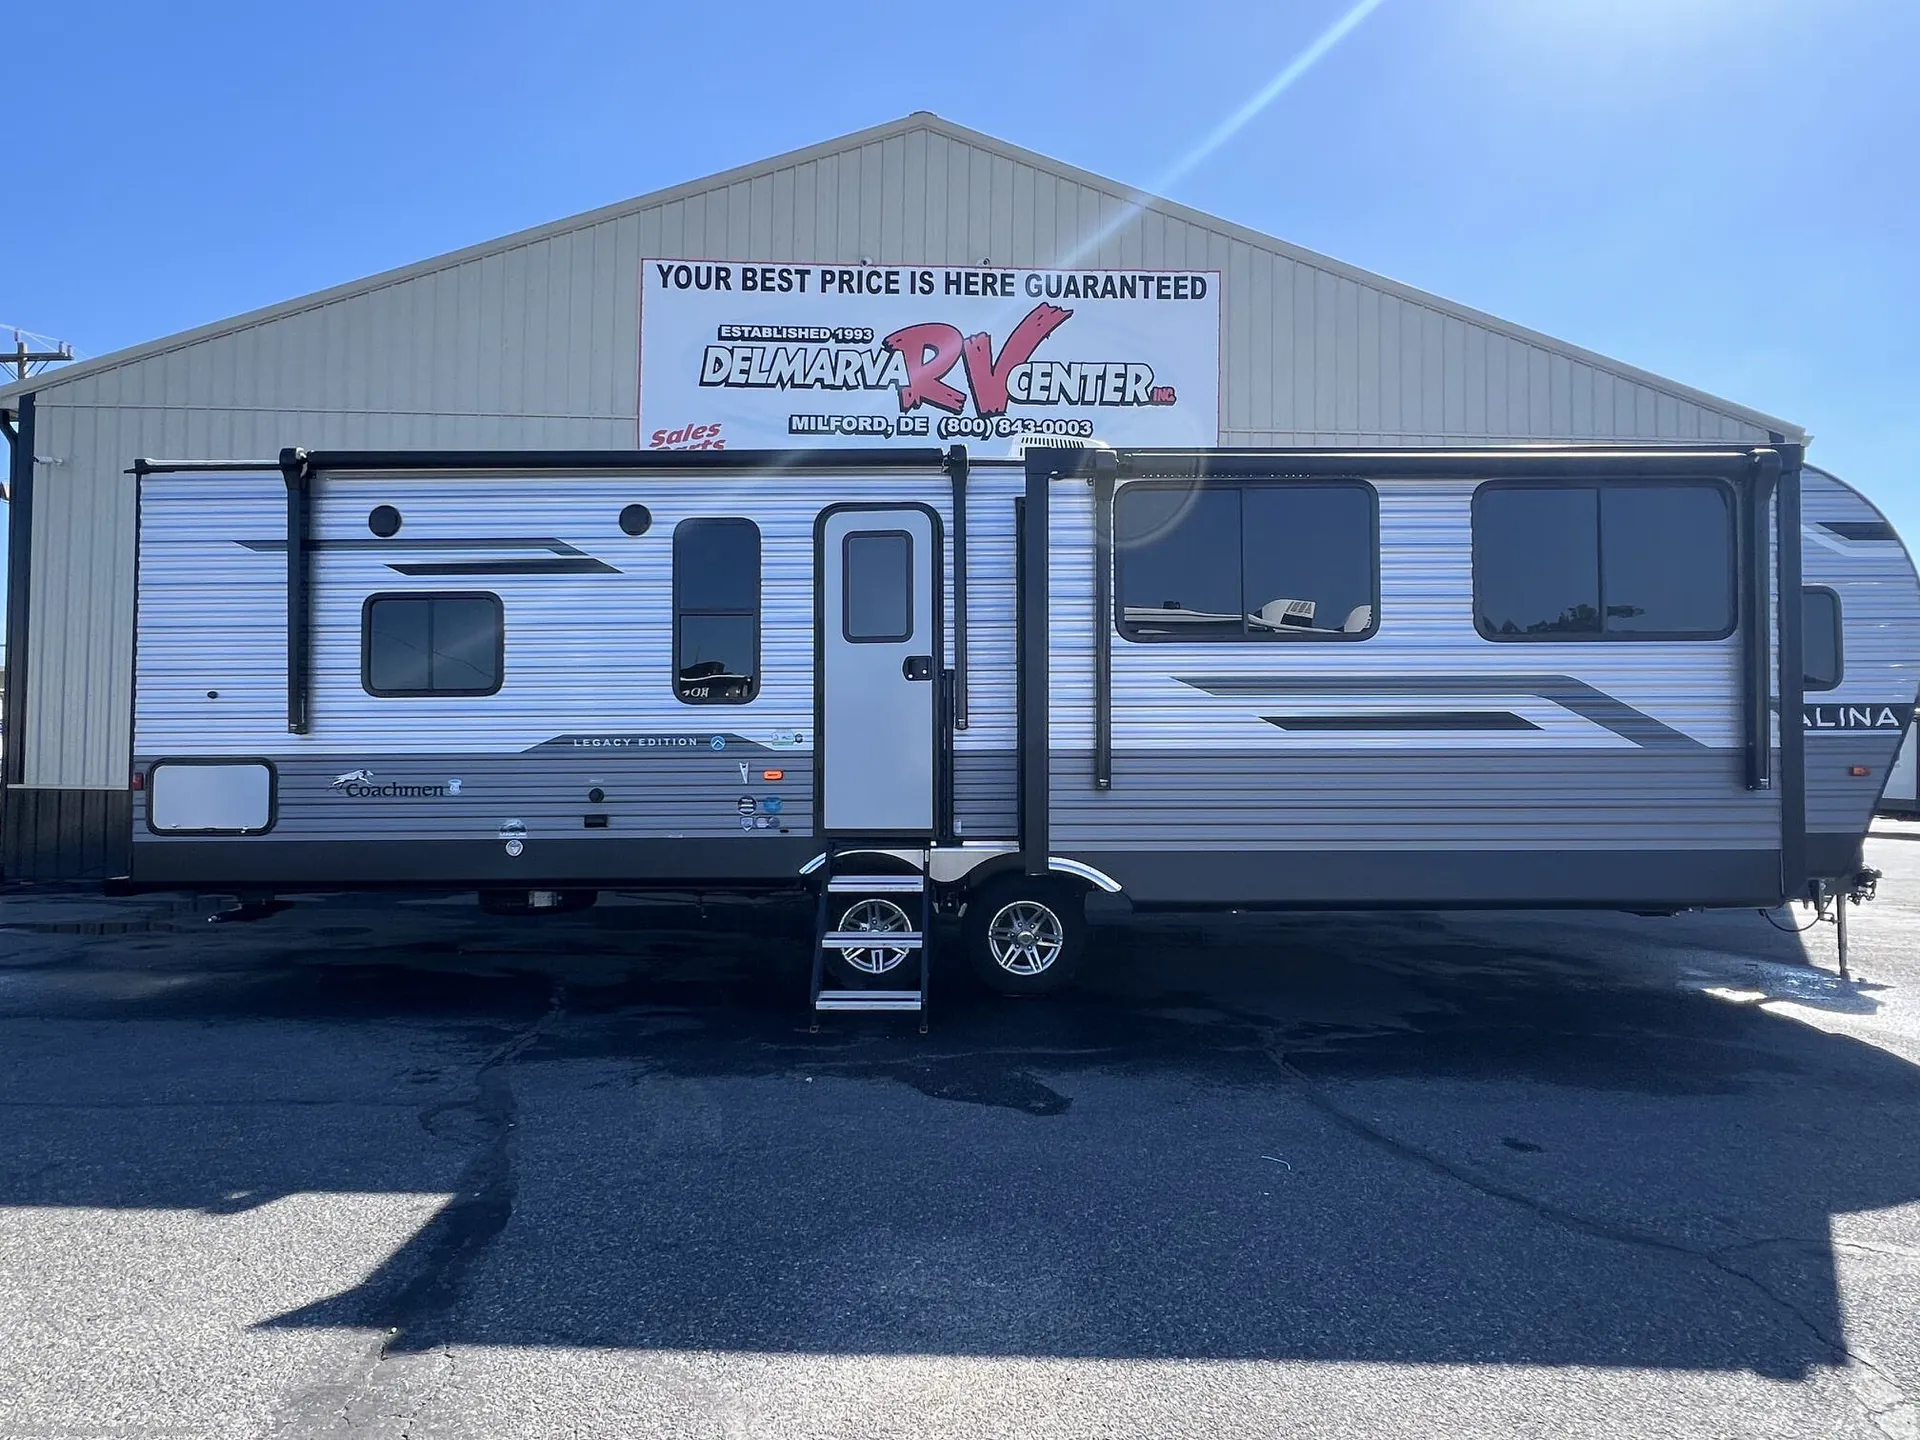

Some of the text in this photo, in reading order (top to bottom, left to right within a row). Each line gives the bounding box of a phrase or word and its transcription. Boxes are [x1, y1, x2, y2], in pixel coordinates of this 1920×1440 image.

[656, 264, 1208, 300] YOUR BEST PRICE IS HERE GUARANTEED
[719, 325, 874, 342] ESTABLISHED 1993
[700, 346, 910, 389] DELMARVA
[883, 302, 1074, 416] RV
[1006, 362, 1154, 406] CENTER
[649, 422, 722, 448] Sales
[790, 415, 1095, 440] MILFORD, DE (800) 843-0003
[573, 737, 698, 747] LEGACY EDITION
[345, 782, 444, 798] Coachmen
